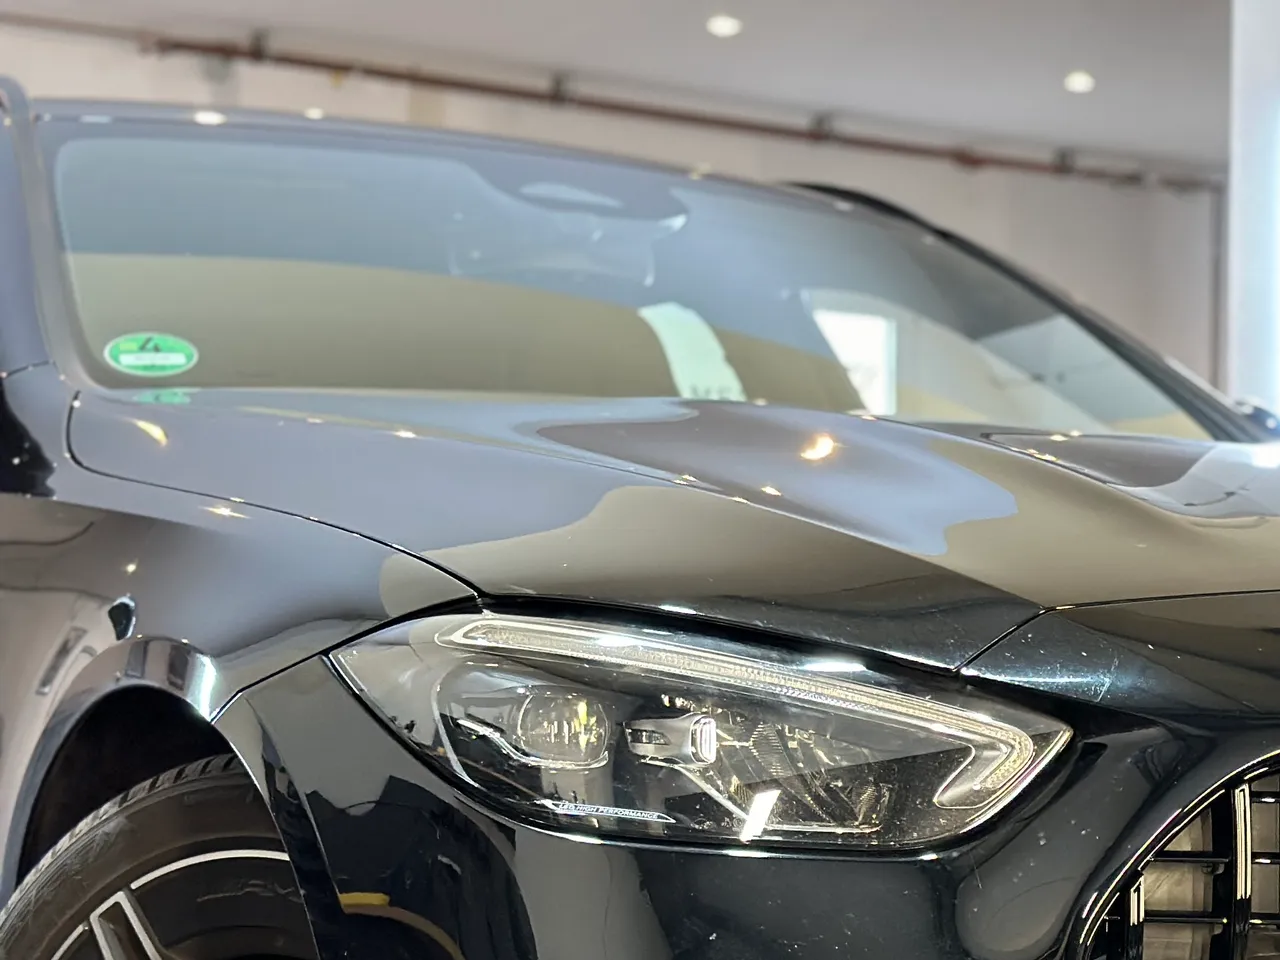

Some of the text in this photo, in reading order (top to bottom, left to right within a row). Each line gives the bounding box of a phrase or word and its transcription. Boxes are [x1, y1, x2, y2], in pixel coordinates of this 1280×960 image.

[559, 802, 658, 819] LED HIGH PERFORMANCE
